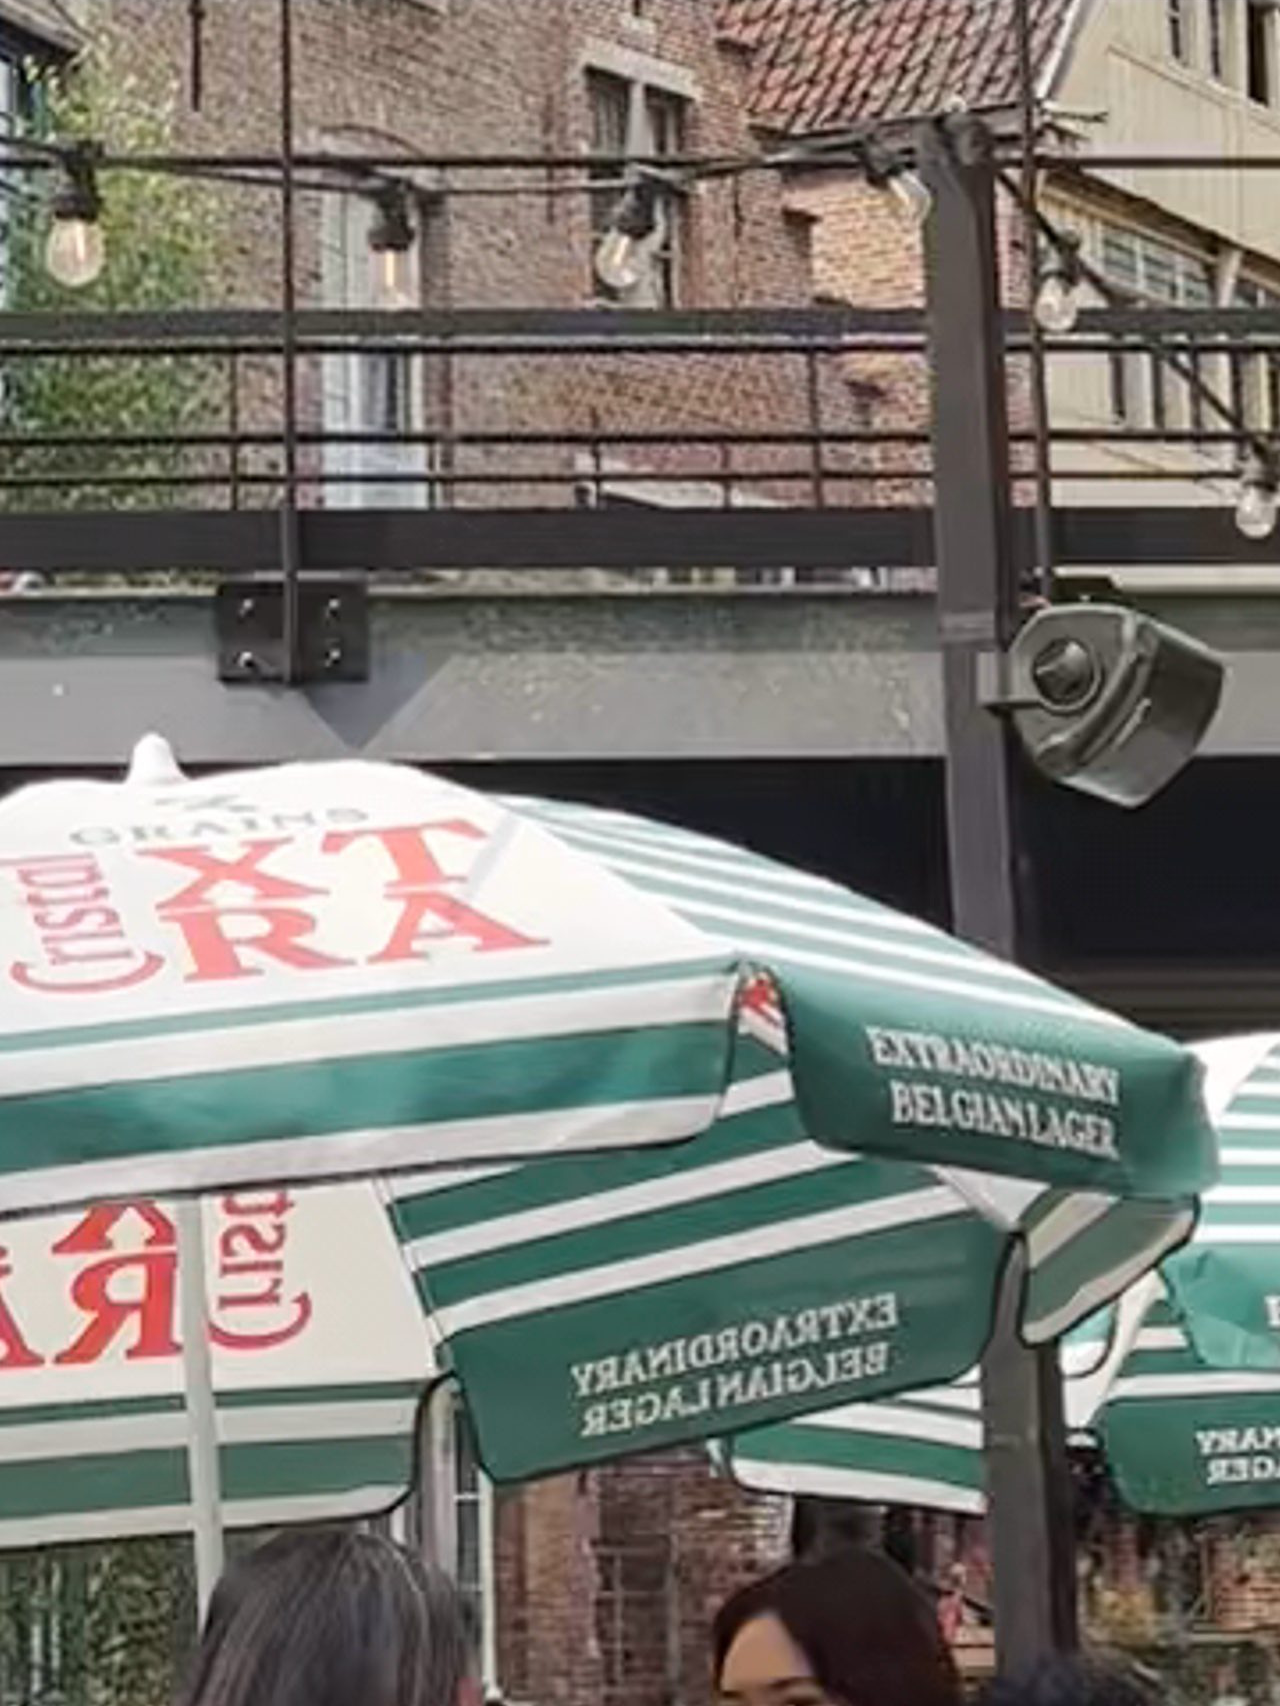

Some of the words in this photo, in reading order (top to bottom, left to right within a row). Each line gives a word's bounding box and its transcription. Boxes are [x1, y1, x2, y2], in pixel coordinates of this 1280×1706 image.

[160, 892, 551, 982] RA
[866, 1026, 1120, 1106] EXTRAORDINARY
[890, 1080, 1028, 1138] BELGIAN
[1029, 1102, 1120, 1162] LAGER
